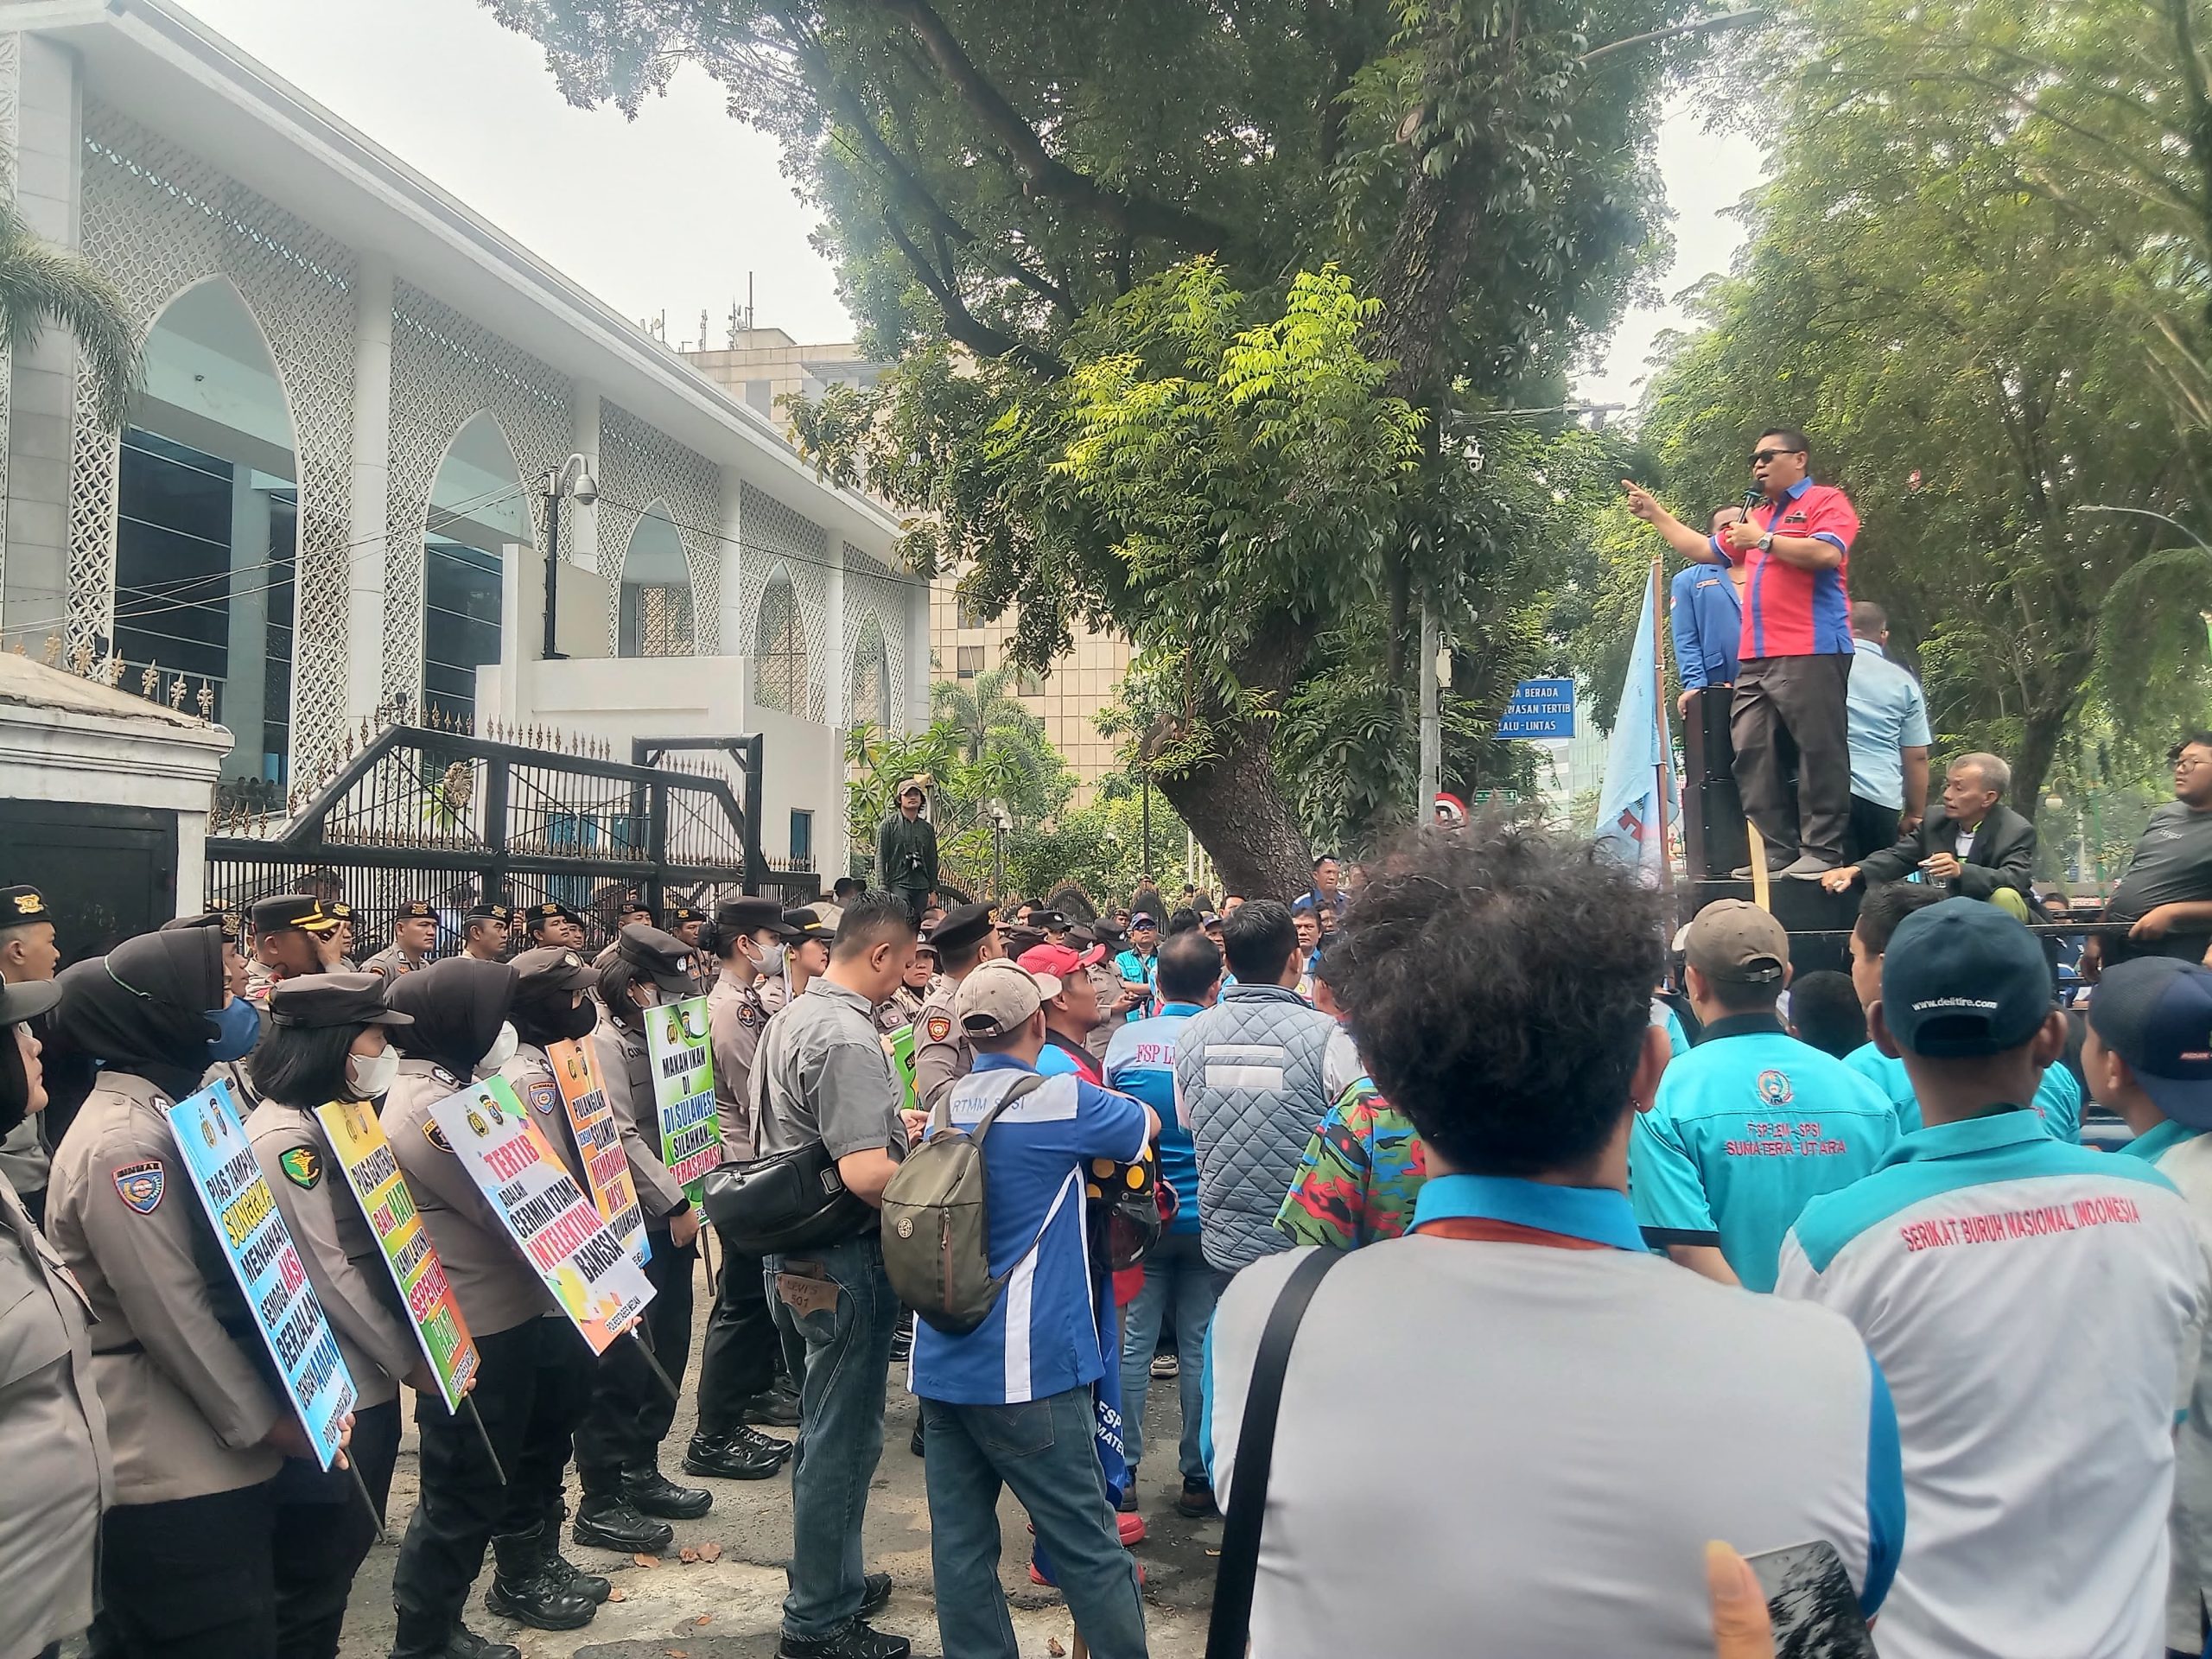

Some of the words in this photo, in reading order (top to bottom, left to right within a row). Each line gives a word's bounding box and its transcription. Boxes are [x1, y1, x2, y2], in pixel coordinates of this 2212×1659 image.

[1524, 688, 1559, 698] BERADA
[1541, 703, 1571, 713] TERTIB
[662, 1051, 689, 1079] MAKAN
[688, 1046, 706, 1070] IKAN
[1135, 1044, 1160, 1063] FSP
[682, 1074, 690, 1096] DI
[952, 1096, 988, 1113] RTMM
[995, 1096, 1025, 1110] SSI
[590, 1116, 618, 1152] SELAMAT
[663, 1106, 676, 1135] DI
[675, 1090, 715, 1129] SULAWESI
[1798, 1122, 1821, 1137] SPSI
[483, 1134, 540, 1183] TERTIB
[590, 1145, 628, 1189] MEMBAWA
[1726, 1141, 1795, 1156] SUMATERA
[205, 1169, 232, 1209] PIAS
[225, 1145, 259, 1192] TAMPAK
[350, 1160, 374, 1198] PIAS
[498, 1180, 528, 1209] ADALAH
[605, 1179, 628, 1215] HASIL
[372, 1202, 397, 1238] BAIK
[385, 1180, 416, 1230] HATI
[509, 1194, 556, 1239] CERMIN
[543, 1175, 582, 1213] UTAMA
[1901, 1218, 1960, 1252] SERIKAT
[1961, 1213, 2007, 1244] BURUH
[2005, 1205, 2076, 1239] NASIONAL
[2073, 1197, 2142, 1229] INDONESIA
[240, 1216, 289, 1287] MENAWAN
[526, 1201, 604, 1273] INTELEKTUAL
[572, 1229, 626, 1284] BANGSA
[260, 1278, 293, 1331] SEMOGA
[277, 1244, 307, 1294] AKSI
[409, 1257, 448, 1325] SEPENUH
[791, 1295, 809, 1307] 501
[276, 1287, 323, 1374] BERJALAN
[309, 1327, 340, 1394] AMAN
